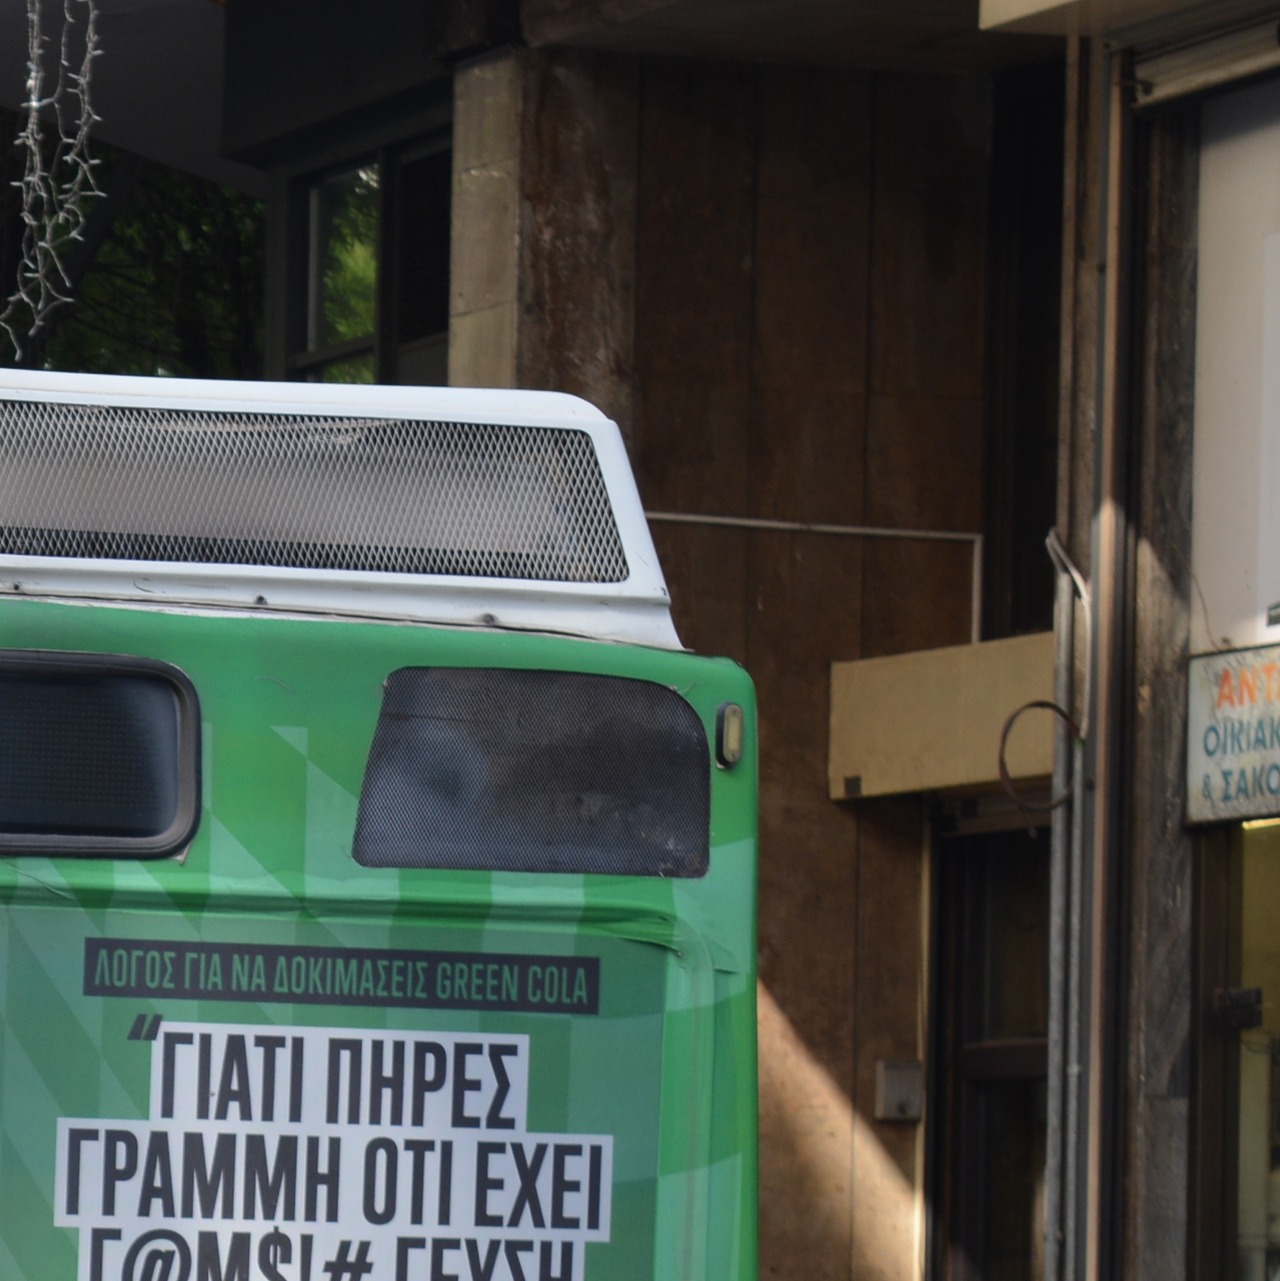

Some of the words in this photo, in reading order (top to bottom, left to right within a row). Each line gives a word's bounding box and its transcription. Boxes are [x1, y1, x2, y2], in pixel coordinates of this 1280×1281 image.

[1216, 662, 1280, 709] ΑΝΤ
[94, 947, 176, 989] ΛΟΓΟΣ
[183, 951, 223, 991] ΓΙΑ
[231, 953, 266, 993] ΝΑ
[273, 954, 428, 998] ΔΟΚΙΜΑΣΕΙΣ
[436, 962, 519, 1002] GREEN
[527, 965, 589, 1006] COLA
[325, 1037, 519, 1130] ΠΗΡΕΣ
[64, 1128, 340, 1223] ΓΡΑΜΜΗ
[361, 1136, 453, 1226] ΟΤΙ
[474, 1141, 602, 1230] ΕΧΕΙ
